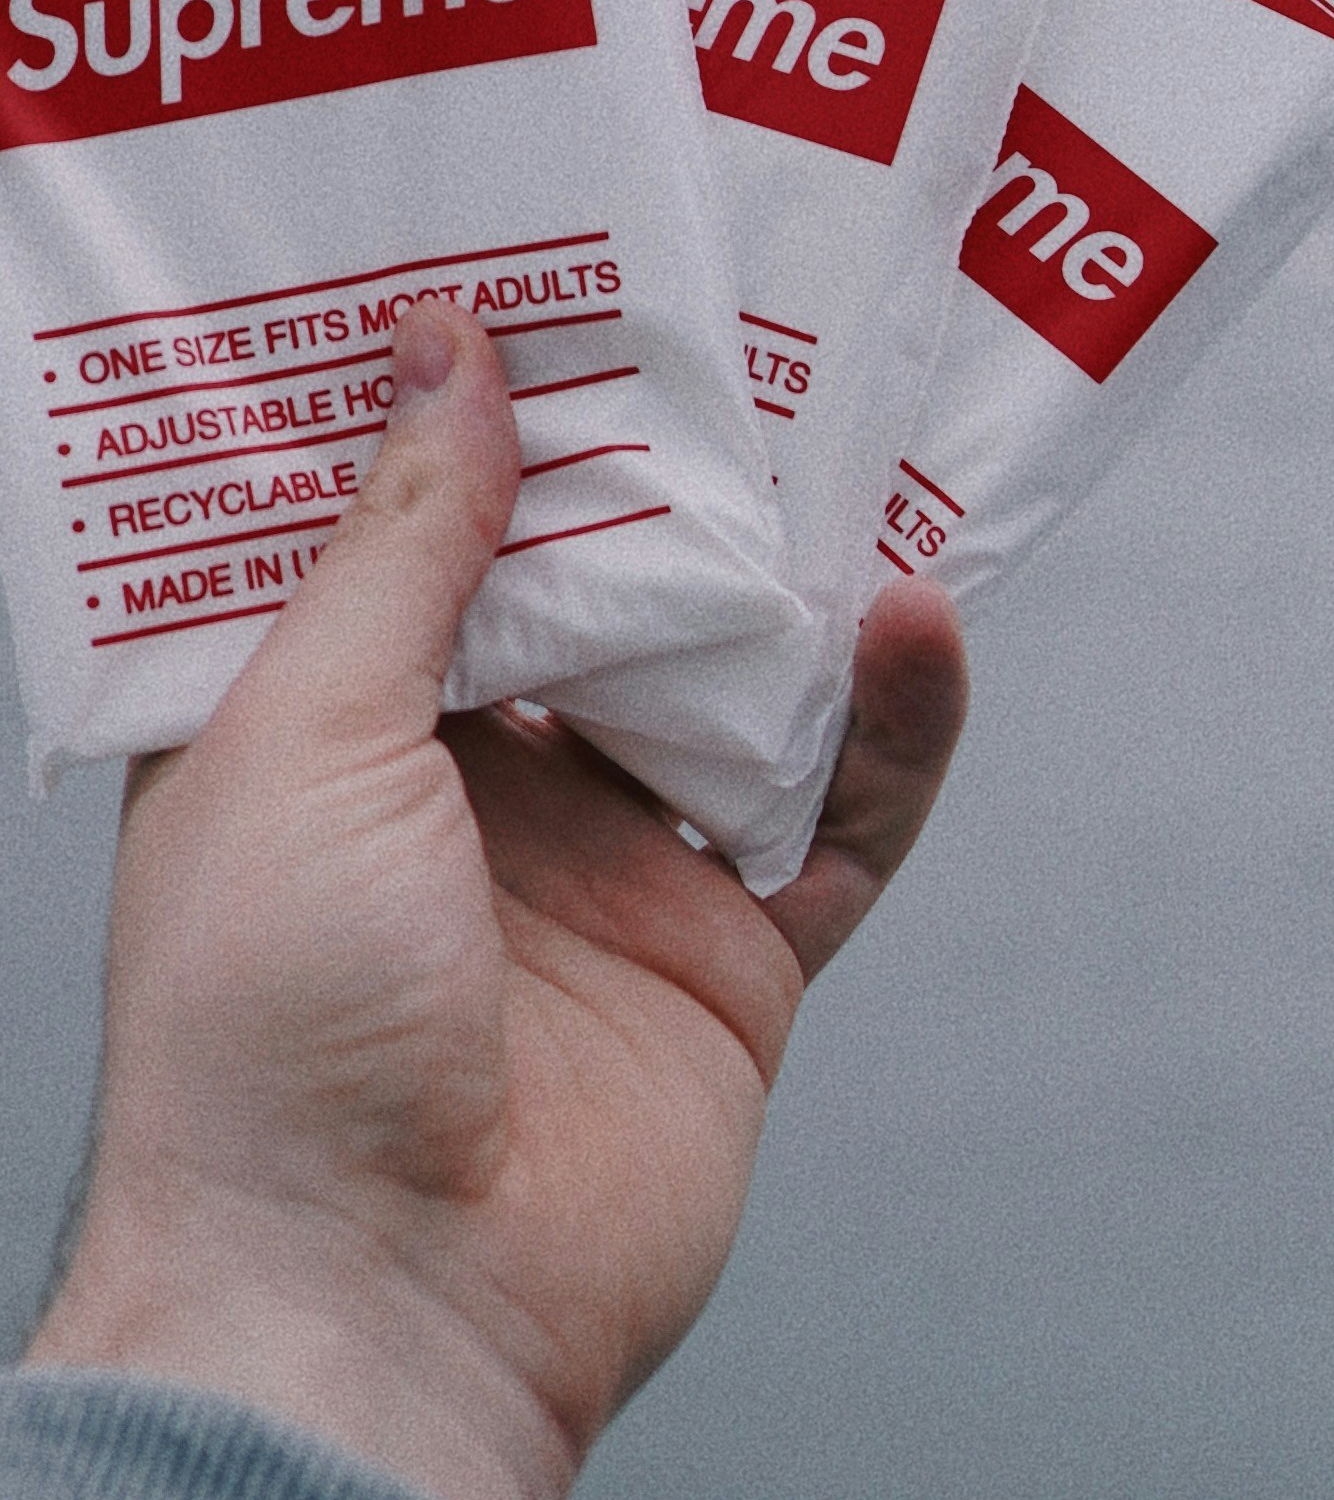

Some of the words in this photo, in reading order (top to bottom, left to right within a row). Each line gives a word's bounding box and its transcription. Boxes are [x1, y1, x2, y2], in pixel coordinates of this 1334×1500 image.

[79, 340, 167, 385] ONE
[173, 326, 255, 367] SIZE
[265, 309, 350, 354] FITS
[471, 261, 622, 315] ADULTS
[744, 344, 811, 394] LTS
[97, 388, 337, 460] ADJUSTABLE
[344, 375, 395, 417] HO
[108, 461, 359, 537] RECYCLABLE
[122, 562, 234, 615] MADE
[245, 553, 284, 590] IN
